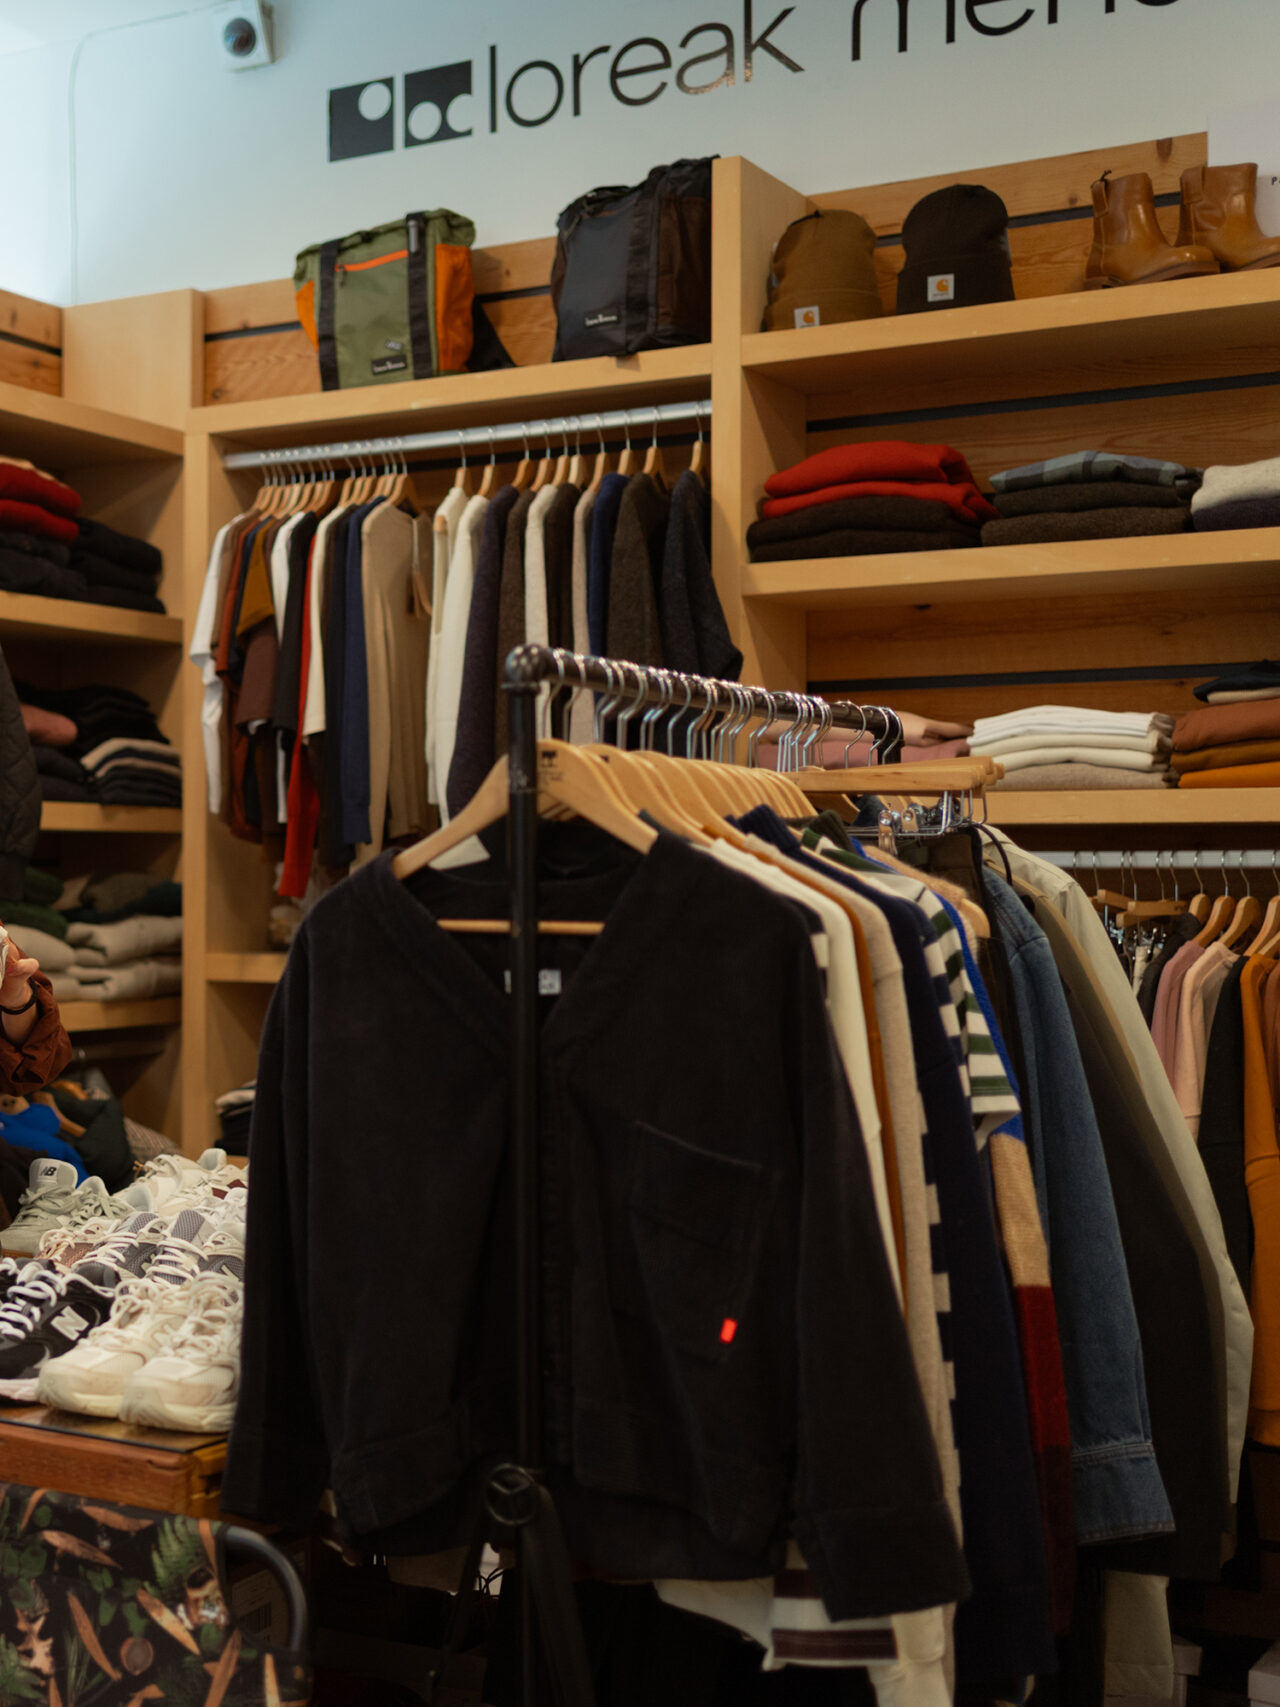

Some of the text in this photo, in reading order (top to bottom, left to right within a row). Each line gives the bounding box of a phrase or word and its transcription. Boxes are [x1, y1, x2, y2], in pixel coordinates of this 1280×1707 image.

[489, 0, 805, 133] loreak
[40, 1166, 57, 1176] NB
[51, 1305, 89, 1341] N
